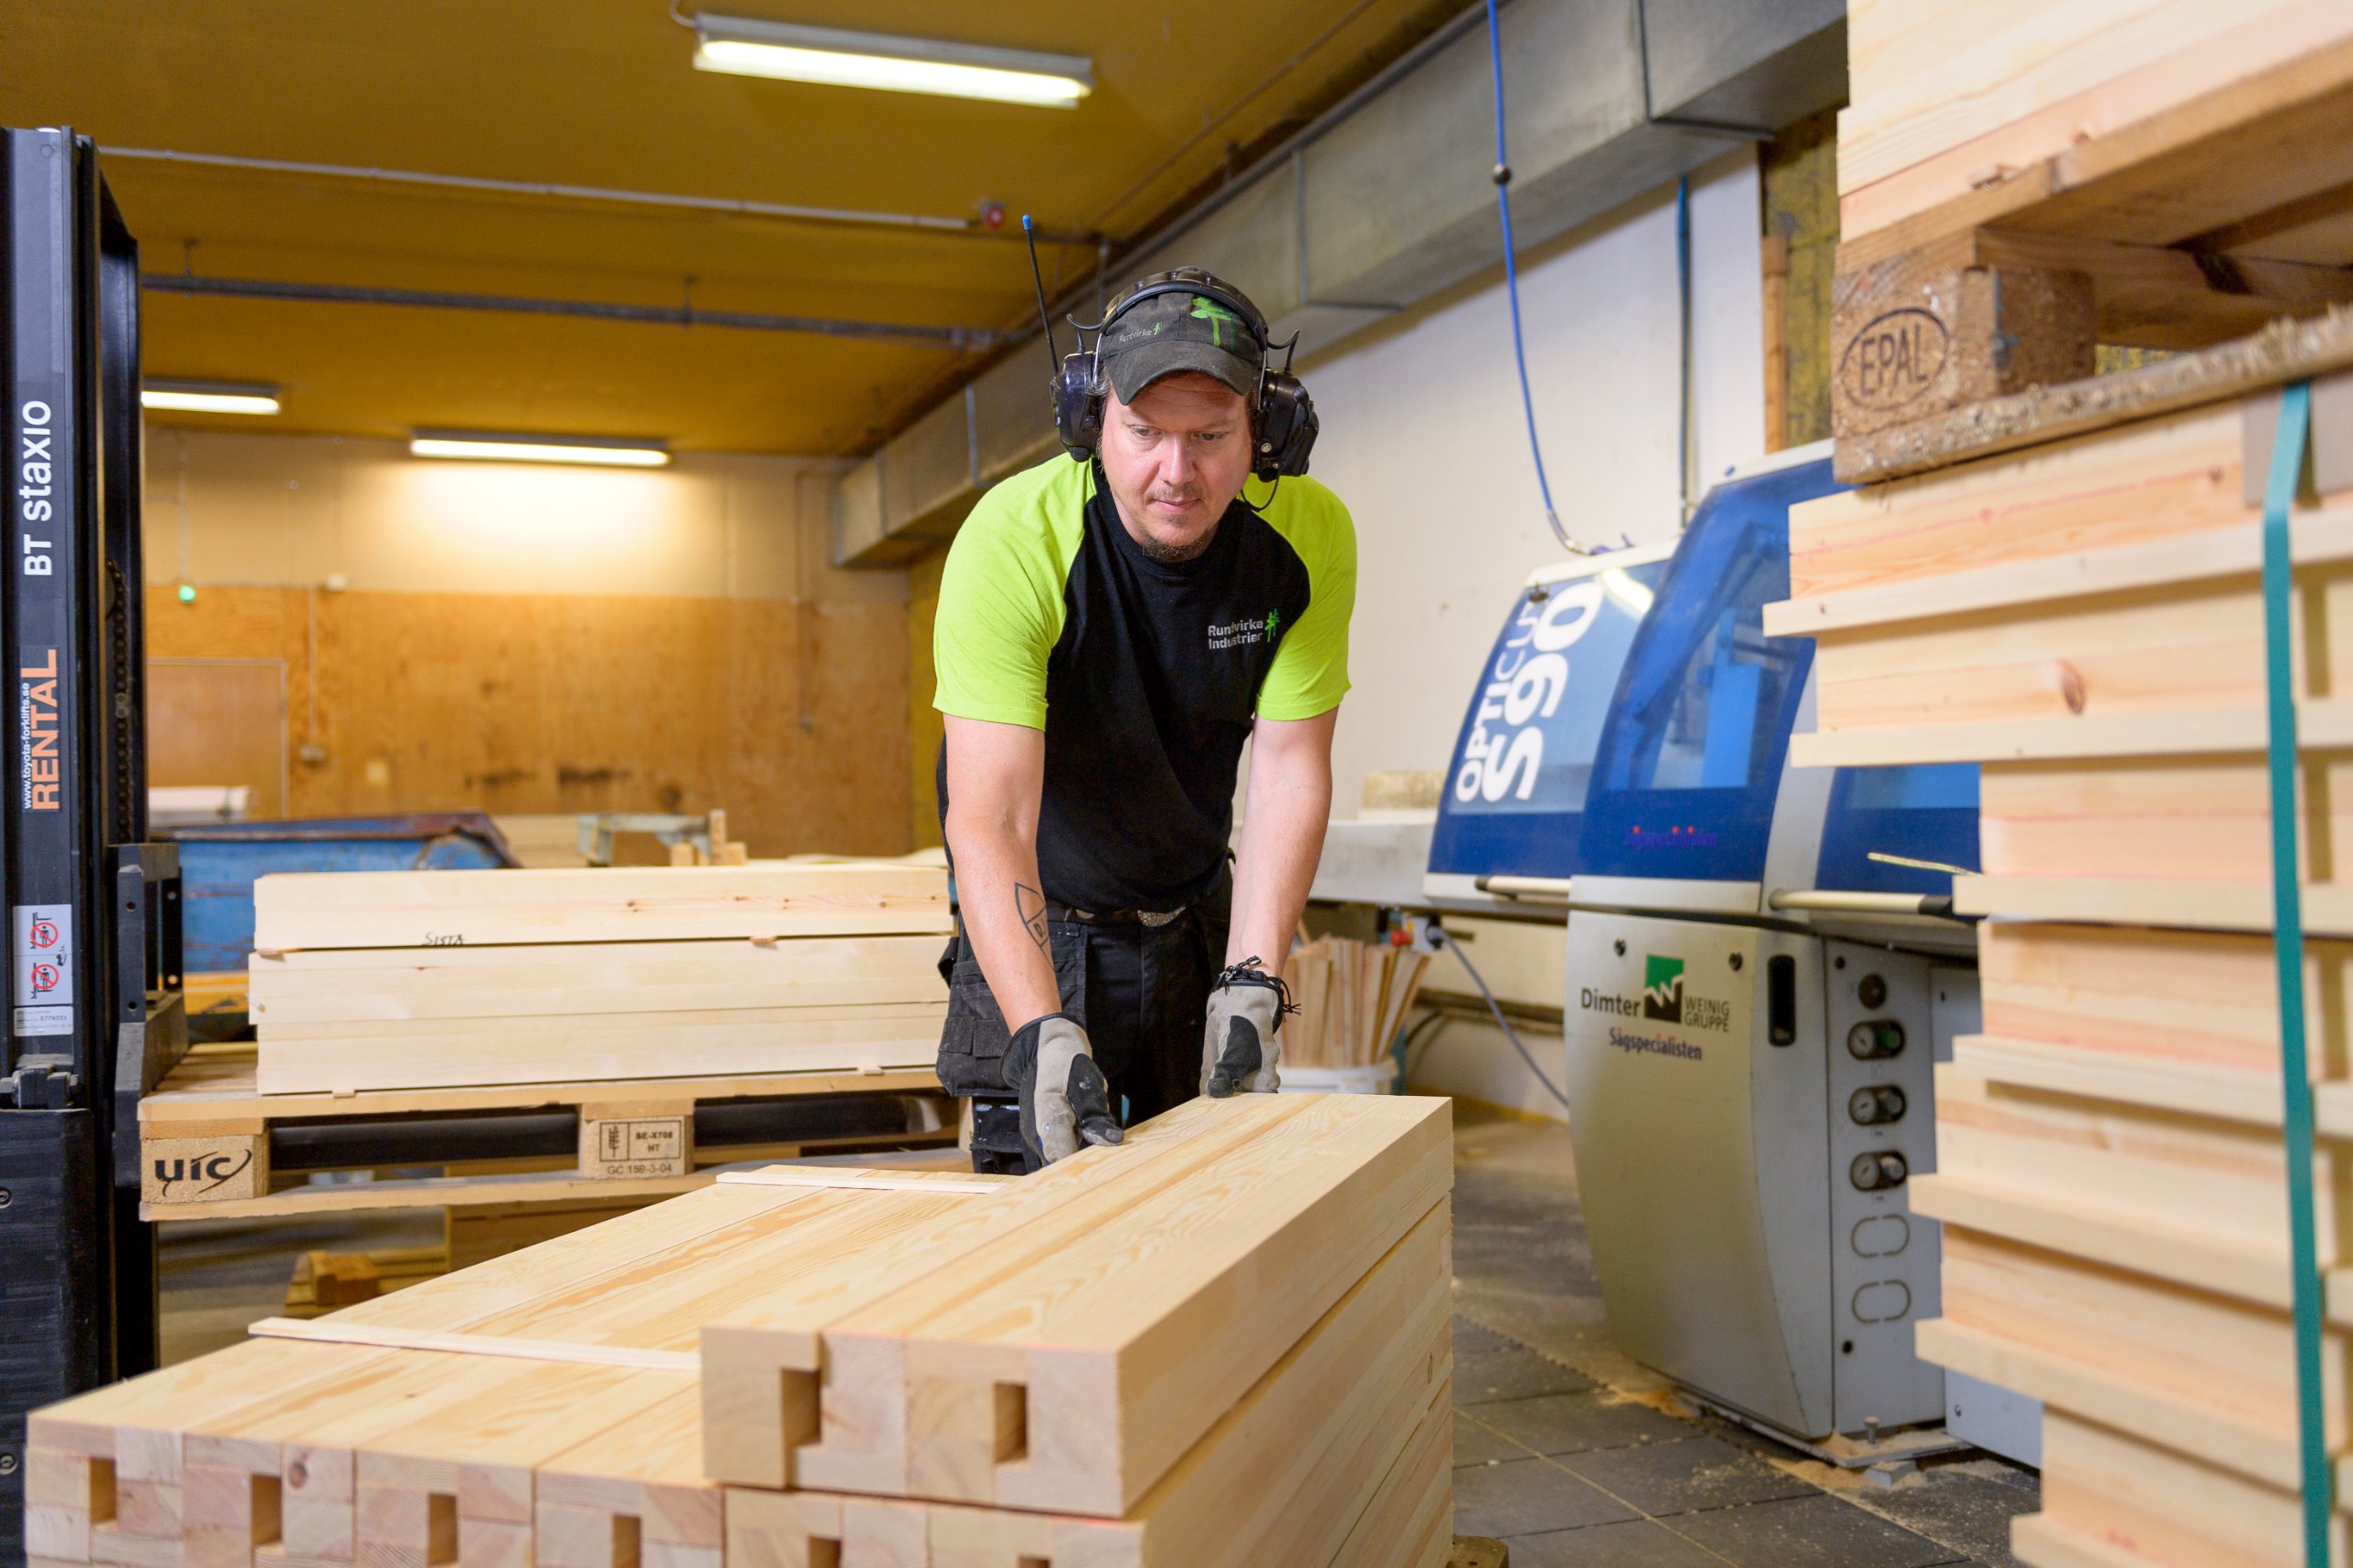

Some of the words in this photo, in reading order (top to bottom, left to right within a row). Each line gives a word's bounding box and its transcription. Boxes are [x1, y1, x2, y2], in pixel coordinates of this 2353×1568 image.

[1860, 323, 1928, 397] EPAL
[19, 400, 53, 522] staxio
[24, 533, 52, 576] BT
[1208, 632, 1263, 649] Industrier
[1455, 598, 1544, 803] OPTICU
[1482, 581, 1605, 803] S90
[20, 649, 59, 810] RENTAL
[21, 682, 33, 809] www.toyota-forklifts.se
[1581, 987, 1641, 1017] Dimter
[1684, 995, 1730, 1016] WEINIG
[1684, 1013, 1729, 1033] GRUPPE
[607, 1165, 624, 1175] GC
